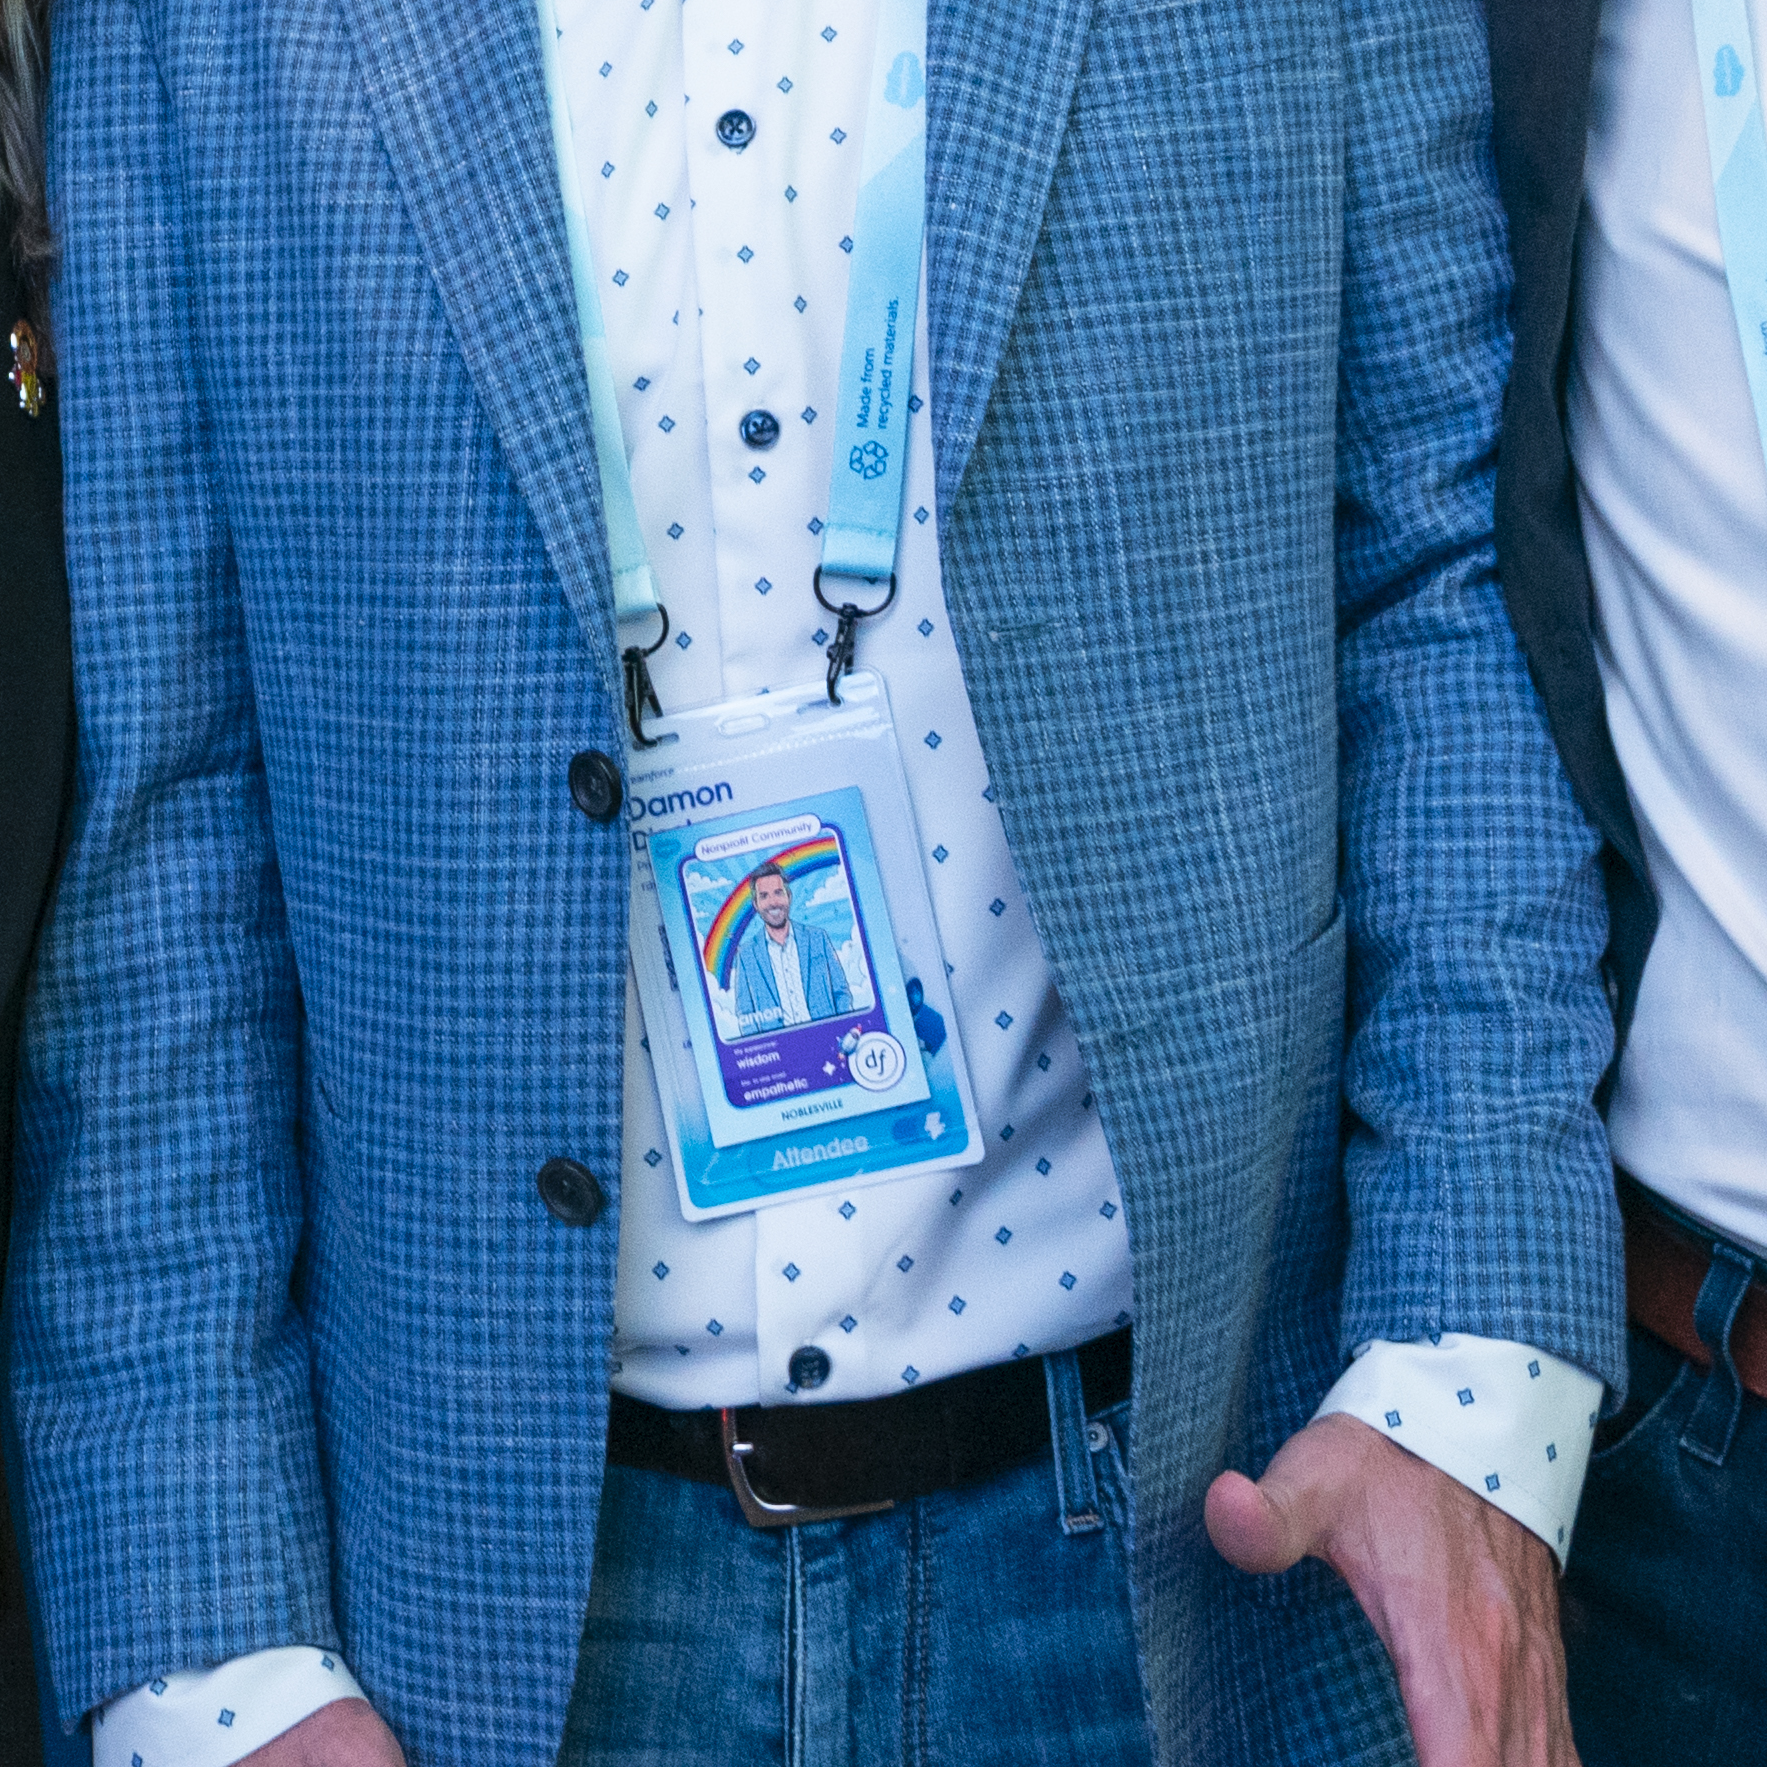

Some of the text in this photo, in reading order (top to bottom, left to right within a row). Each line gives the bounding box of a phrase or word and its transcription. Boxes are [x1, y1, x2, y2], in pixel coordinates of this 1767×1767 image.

[856, 347, 875, 429] Made from
[877, 369, 893, 430] recycled
[700, 821, 812, 856] Nonprofit Community
[736, 1051, 781, 1070] wisdom
[865, 1048, 887, 1076] df
[743, 1077, 809, 1102] empathetic
[781, 1098, 844, 1122] NOBLESVILLE
[771, 1135, 869, 1171] Attendee
